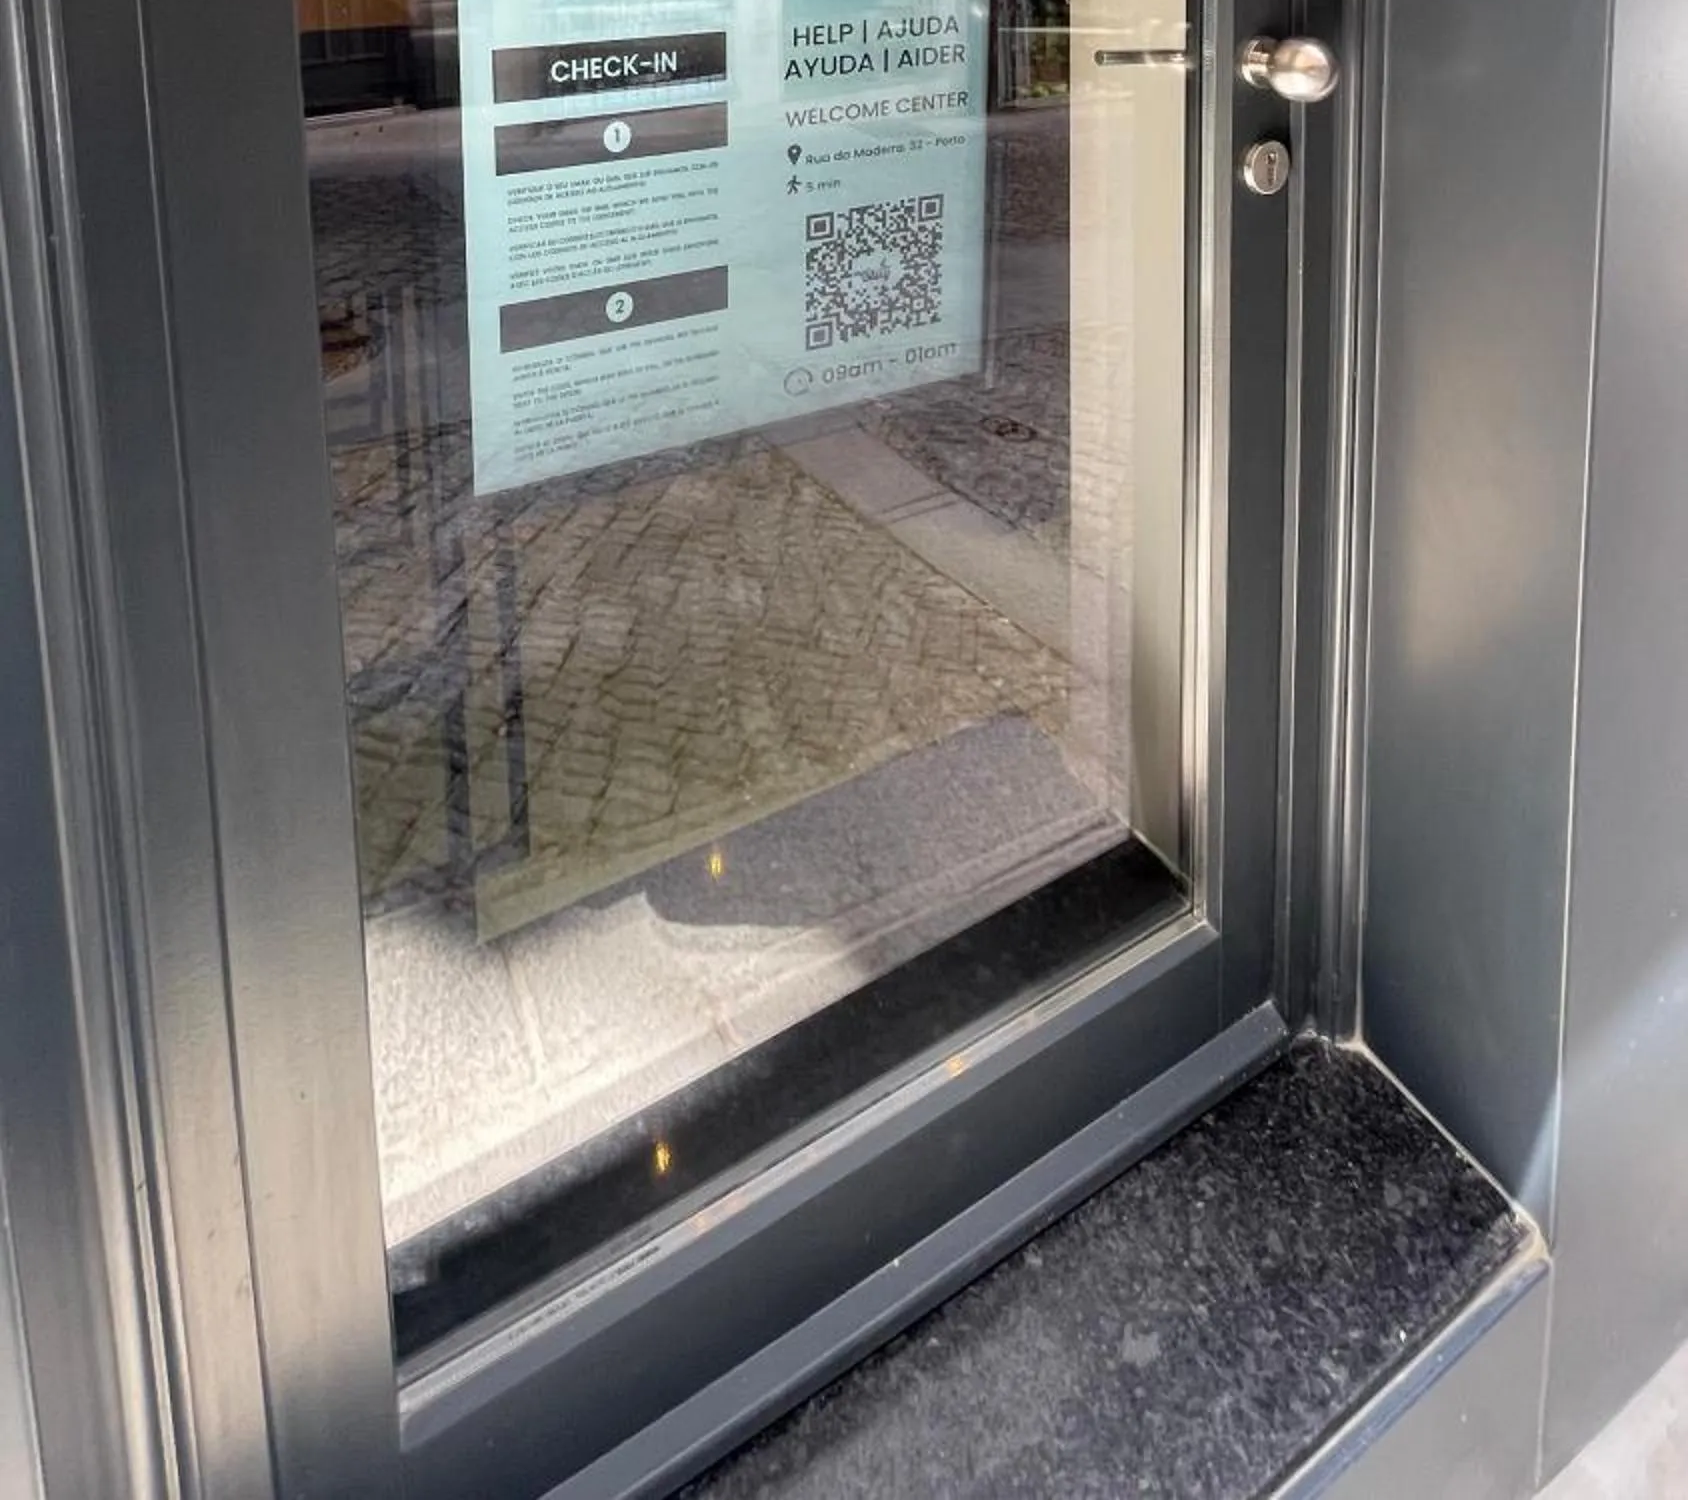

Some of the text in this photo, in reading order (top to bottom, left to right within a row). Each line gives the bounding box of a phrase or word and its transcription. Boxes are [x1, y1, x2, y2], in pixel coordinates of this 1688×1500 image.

[793, 23, 854, 48] HELP
[877, 15, 960, 41] AJUDA
[551, 51, 678, 82] CHECK-IN
[784, 53, 875, 80] AYUDA
[897, 44, 966, 69] AIDER
[785, 91, 969, 128] WELCOME CENTER
[614, 128, 621, 143] 1
[805, 154, 831, 165] Rua
[935, 135, 966, 147] Porto
[817, 179, 841, 191] min
[615, 299, 625, 315] 2
[822, 359, 884, 384] 09am
[905, 342, 957, 365] 01am
